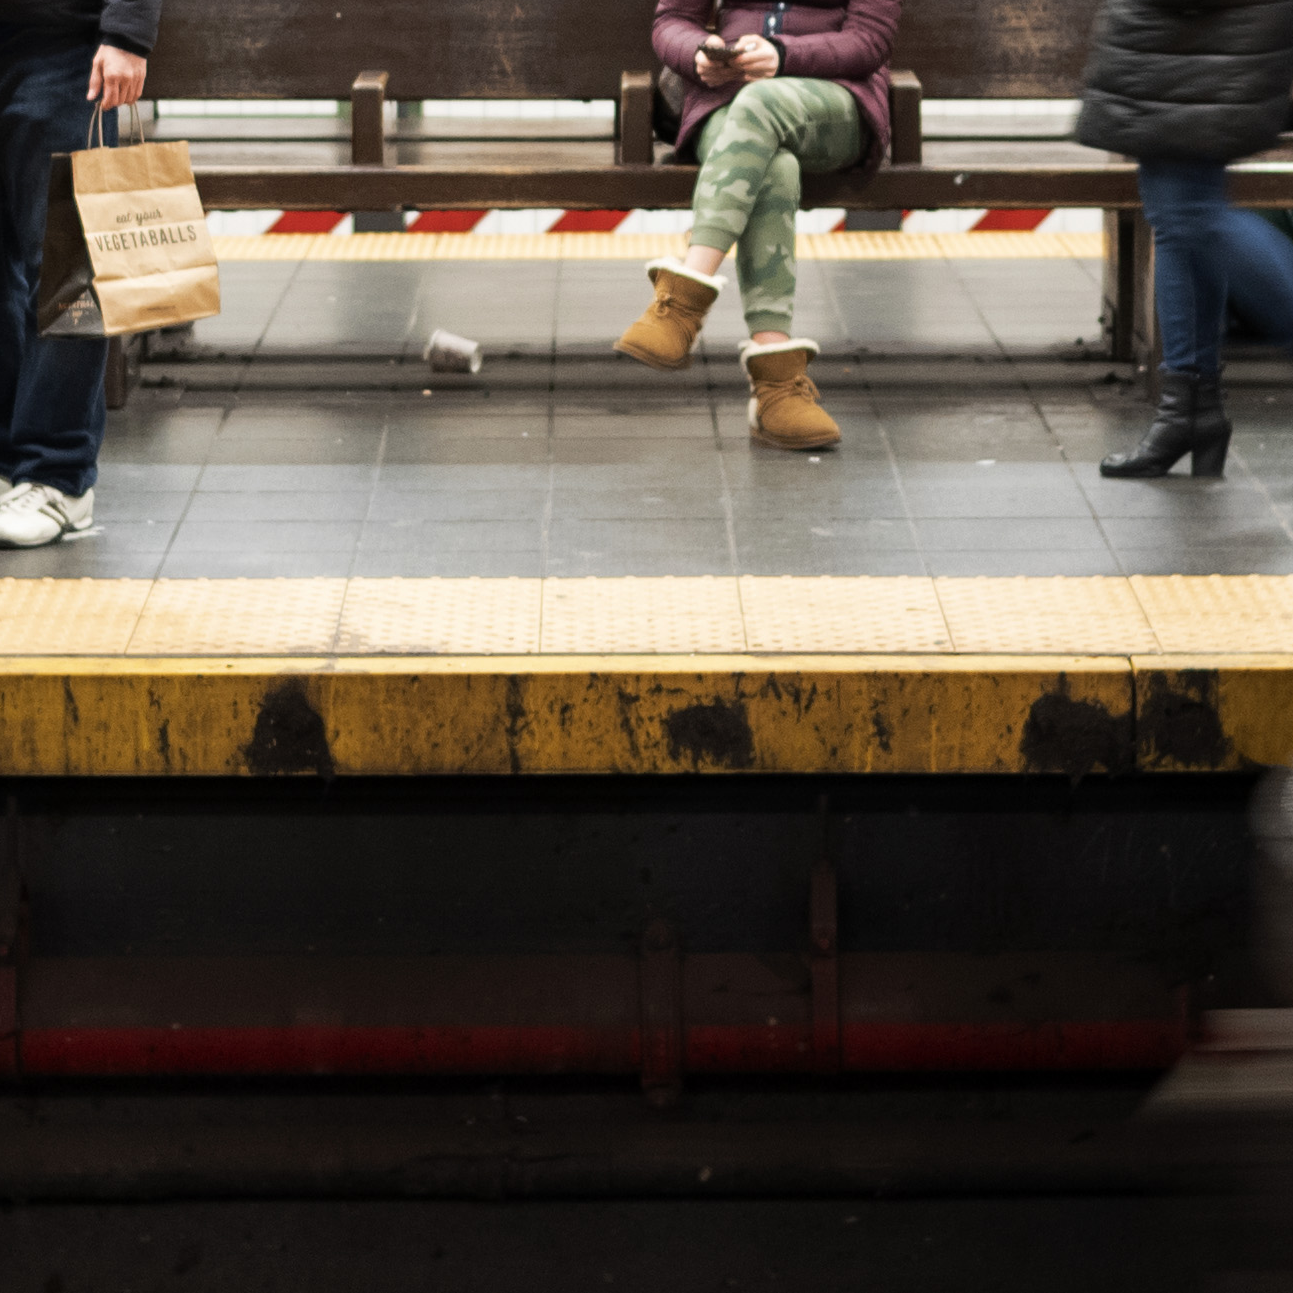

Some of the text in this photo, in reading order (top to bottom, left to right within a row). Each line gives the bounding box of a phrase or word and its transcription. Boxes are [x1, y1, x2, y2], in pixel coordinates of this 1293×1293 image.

[116, 209, 163, 226] eat your
[95, 224, 197, 252] VEGETABALLS
